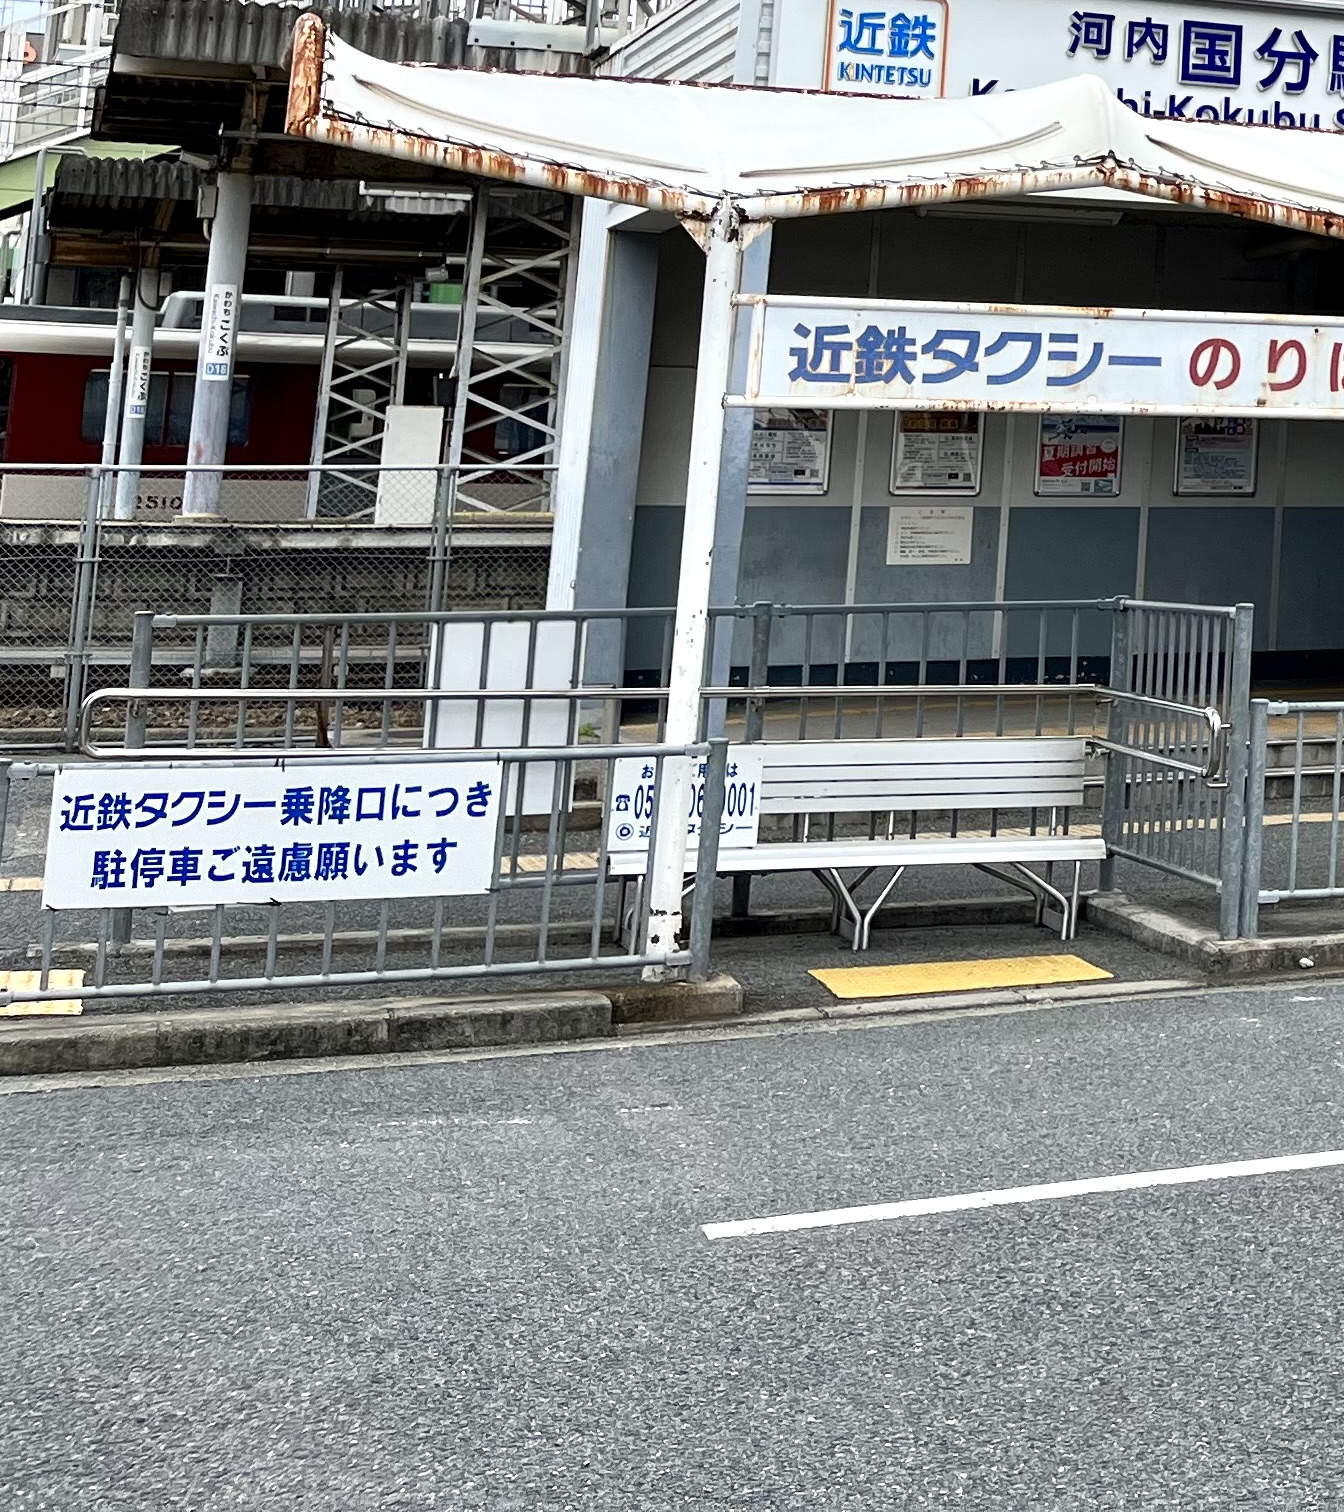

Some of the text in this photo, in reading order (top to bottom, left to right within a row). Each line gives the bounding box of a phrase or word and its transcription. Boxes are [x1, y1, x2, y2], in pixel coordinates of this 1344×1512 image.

[837, 8, 938, 59] 近鉄
[838, 61, 932, 87] KINTETSU
[788, 324, 1162, 387] 近鉄タクシー
[59, 781, 493, 832] 近鉄タクシー乗降口につき
[90, 837, 458, 889] 駐停車ご遠慮願います
